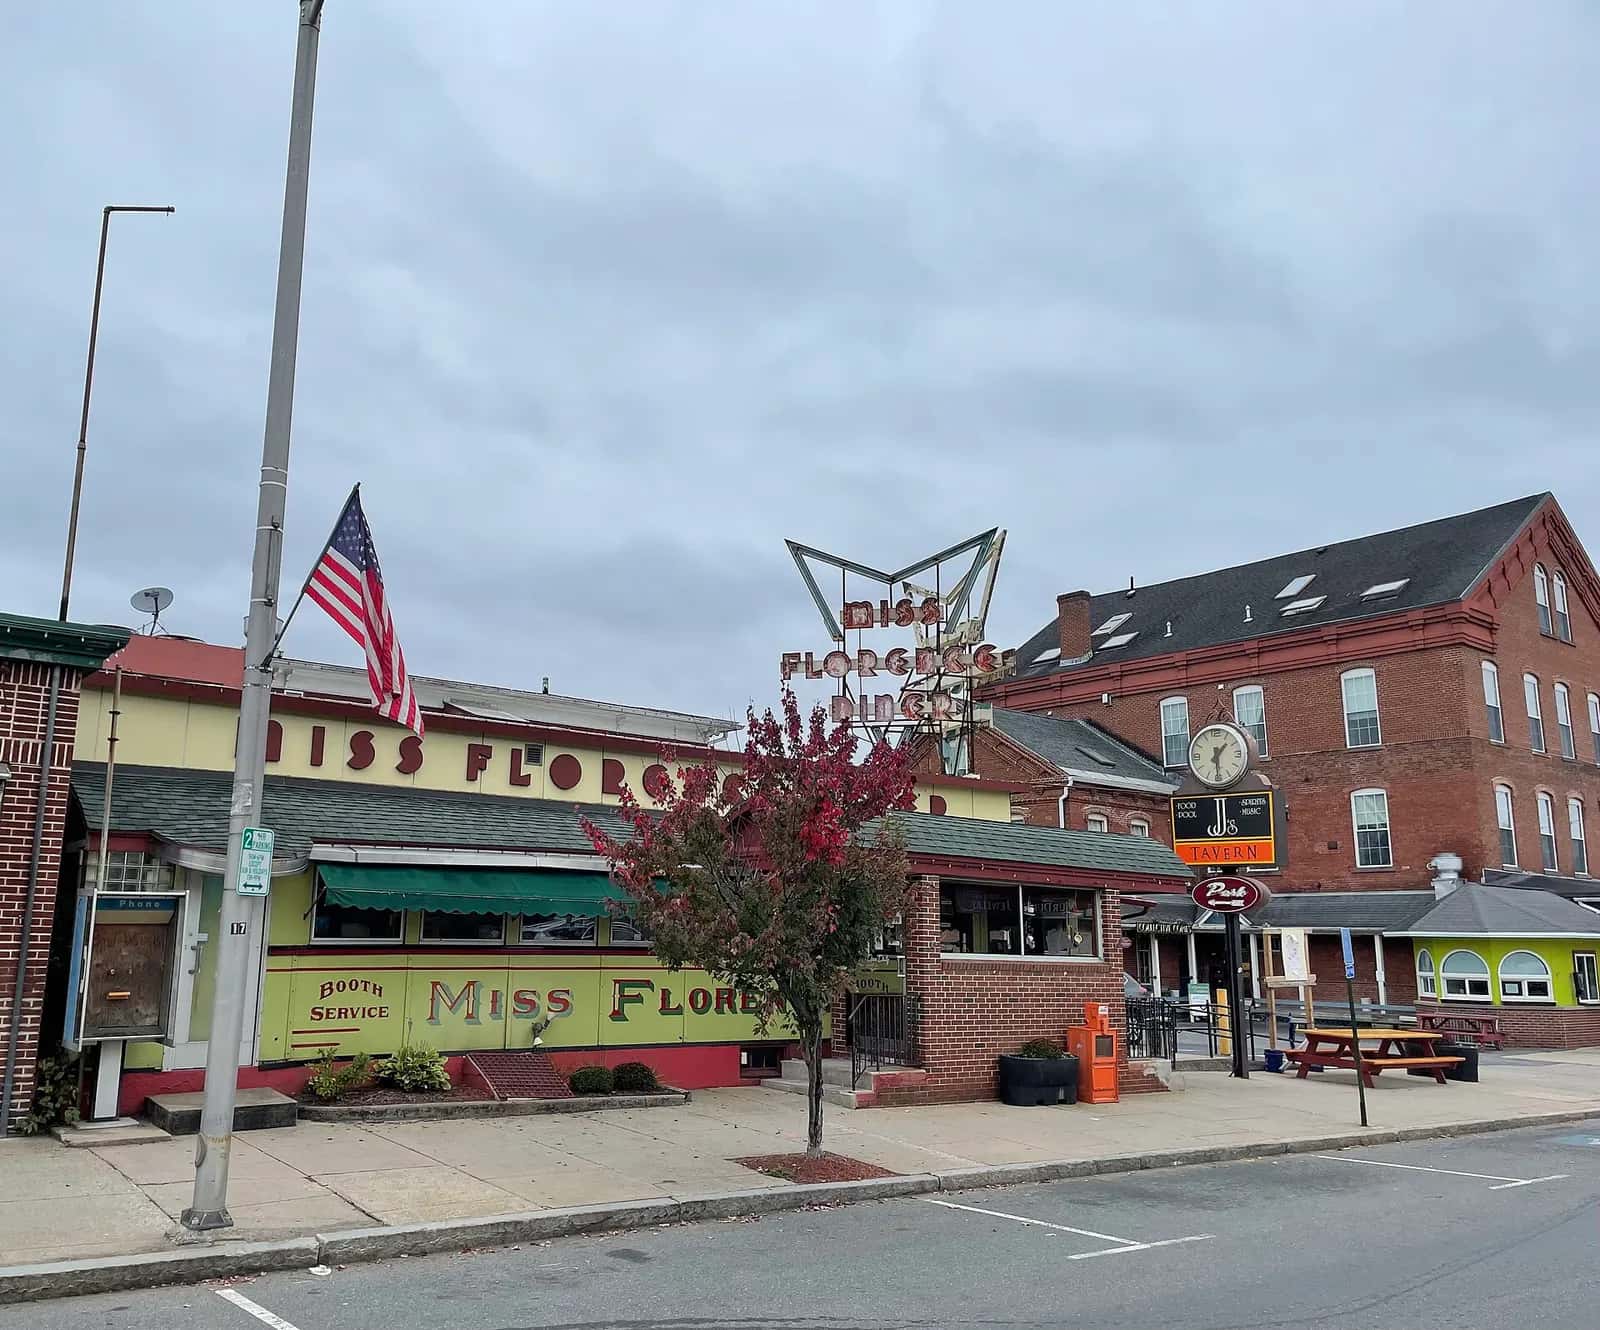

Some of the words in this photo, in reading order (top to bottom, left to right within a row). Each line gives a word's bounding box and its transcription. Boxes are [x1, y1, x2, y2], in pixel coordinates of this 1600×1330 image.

[843, 597, 941, 629] MISS
[781, 645, 998, 680] FLORENCE
[831, 693, 953, 722] DINER
[1177, 802, 1197, 810] FOOD
[1241, 807, 1262, 815] MUSIC
[244, 831, 252, 848] 2
[1191, 845, 1257, 861] TAVERN
[1205, 881, 1249, 898] Park
[119, 899, 161, 908] Phone
[232, 923, 246, 934] 17
[320, 980, 384, 1000] BOOTH
[427, 979, 574, 1027] MISS
[310, 1005, 390, 1022] SERVICE
